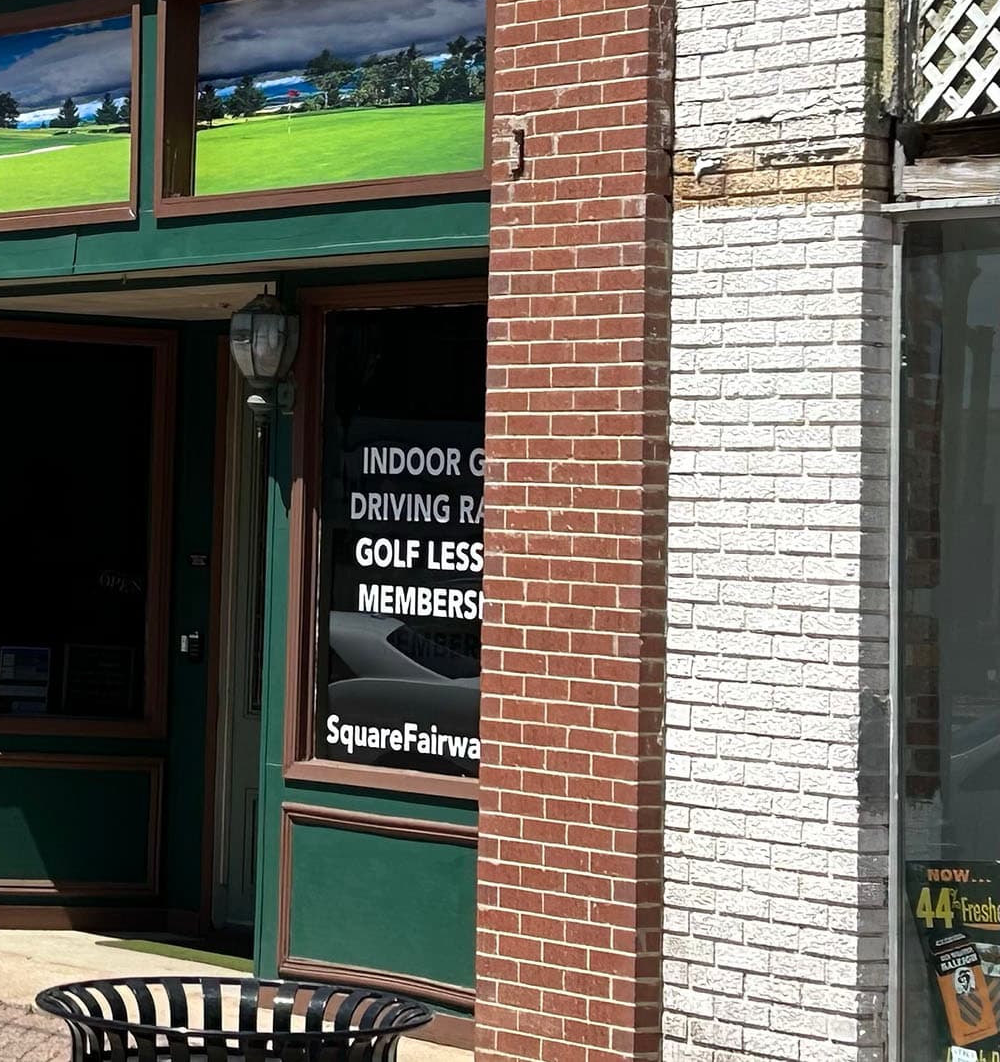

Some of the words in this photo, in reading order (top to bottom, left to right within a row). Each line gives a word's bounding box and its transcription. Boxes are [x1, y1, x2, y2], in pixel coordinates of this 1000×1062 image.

[363, 446, 461, 476] INDOOR
[351, 492, 450, 524] DRIVING
[355, 537, 419, 568] GOLF
[428, 540, 484, 573] LESS
